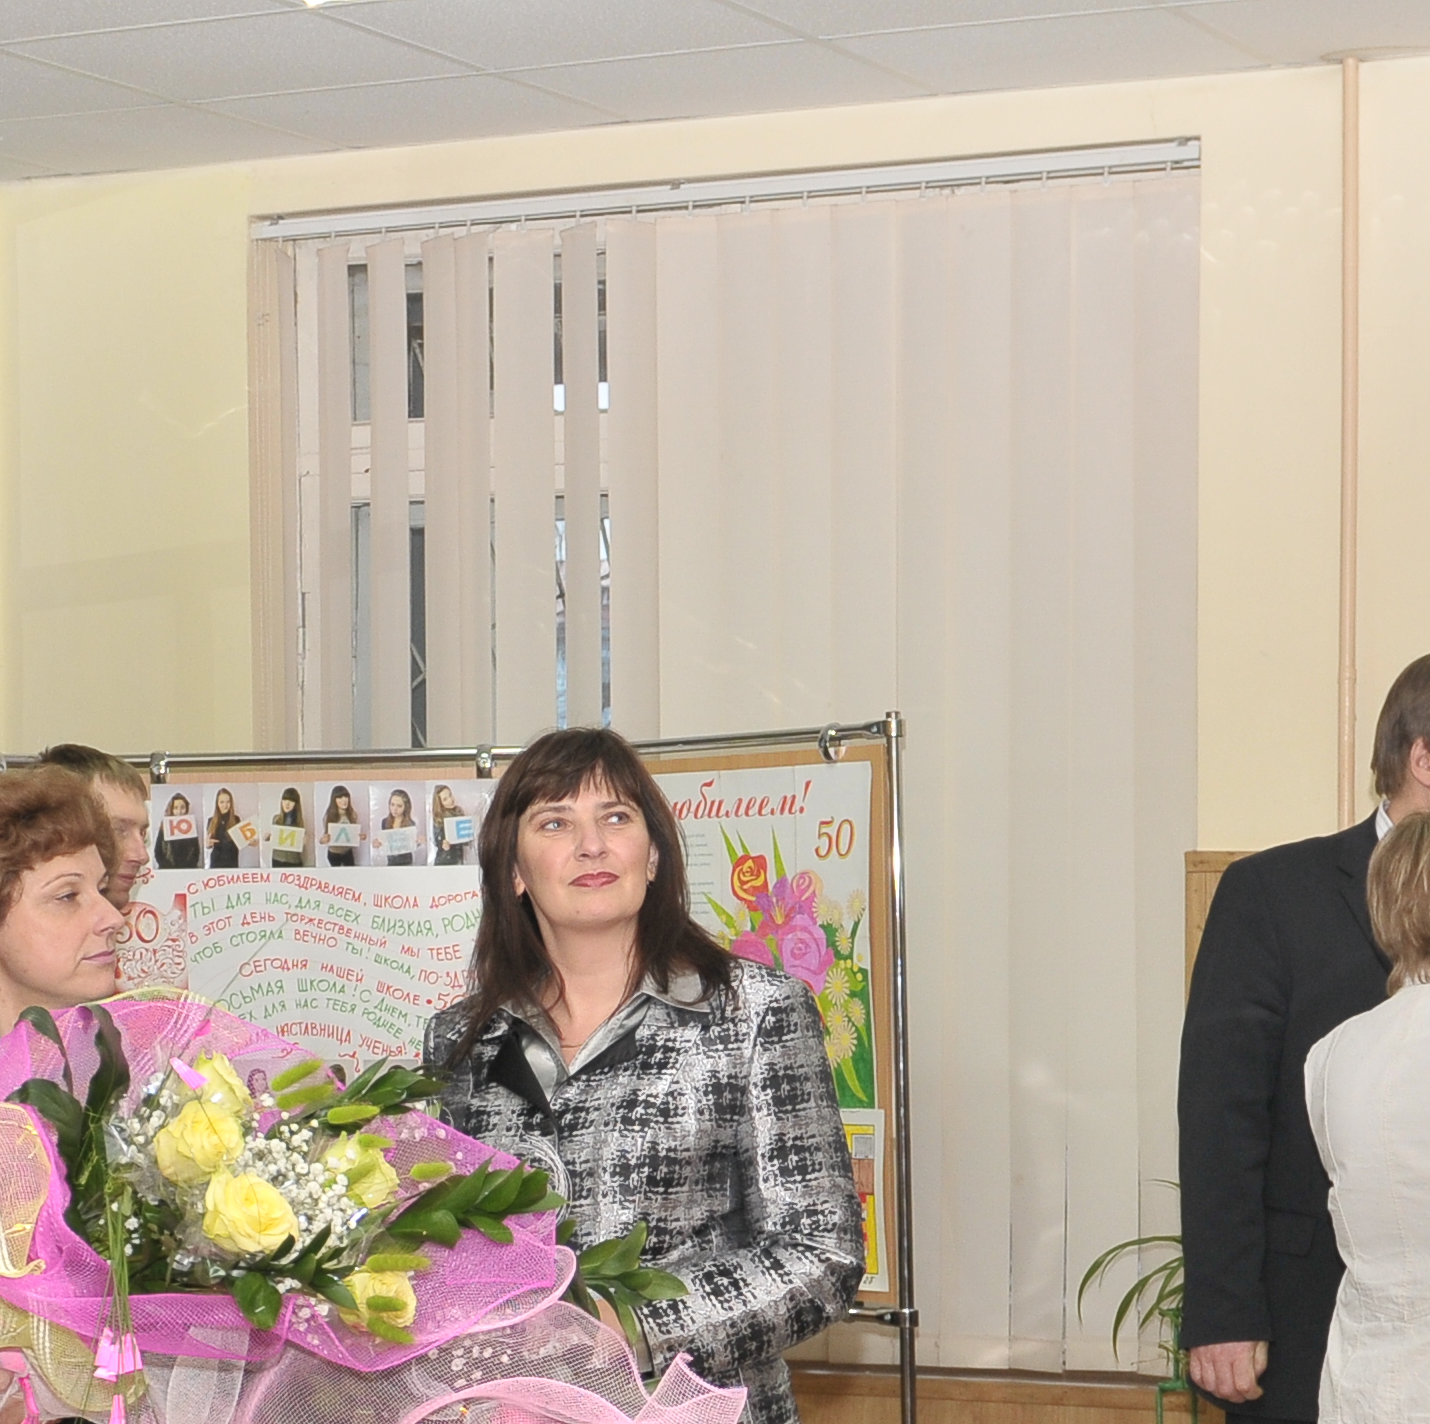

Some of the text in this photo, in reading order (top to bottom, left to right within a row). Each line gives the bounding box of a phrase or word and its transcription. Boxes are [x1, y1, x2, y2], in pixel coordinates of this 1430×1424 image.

[814, 816, 856, 860] 50
[187, 883, 199, 895] С
[202, 872, 271, 891] ЮБИЛЕЕМ
[373, 893, 419, 910] ШКОЛА
[429, 889, 481, 909] ДОРОГА
[189, 898, 216, 919] ТЫ
[225, 891, 252, 910] ДЛЯ
[294, 896, 321, 911] ДЛЯ
[327, 903, 361, 925] ВСЕХ
[188, 912, 463, 961] В ЭТОТ ДЕНЬ ТОРЖЕСТВЕННЫЙ МЫ ТЕБЕ
[190, 941, 223, 965] ЧТОБ
[229, 929, 284, 948] СТОЯЛА
[294, 929, 338, 949] ВЕЧНО
[214, 979, 285, 1013] ОСЬМАЯ
[239, 958, 309, 978] СЕГОДНЯ
[321, 962, 365, 984] НАШЕЙ
[376, 980, 421, 1007] ШКОЛЕ
[263, 1000, 287, 1020] ДЛЯ
[295, 998, 318, 1010] НАС
[325, 998, 357, 1014] ТЕБЯ
[362, 1007, 404, 1040] РОДНЕЕ
[276, 1021, 352, 1045] НАСТАВНИЦА
